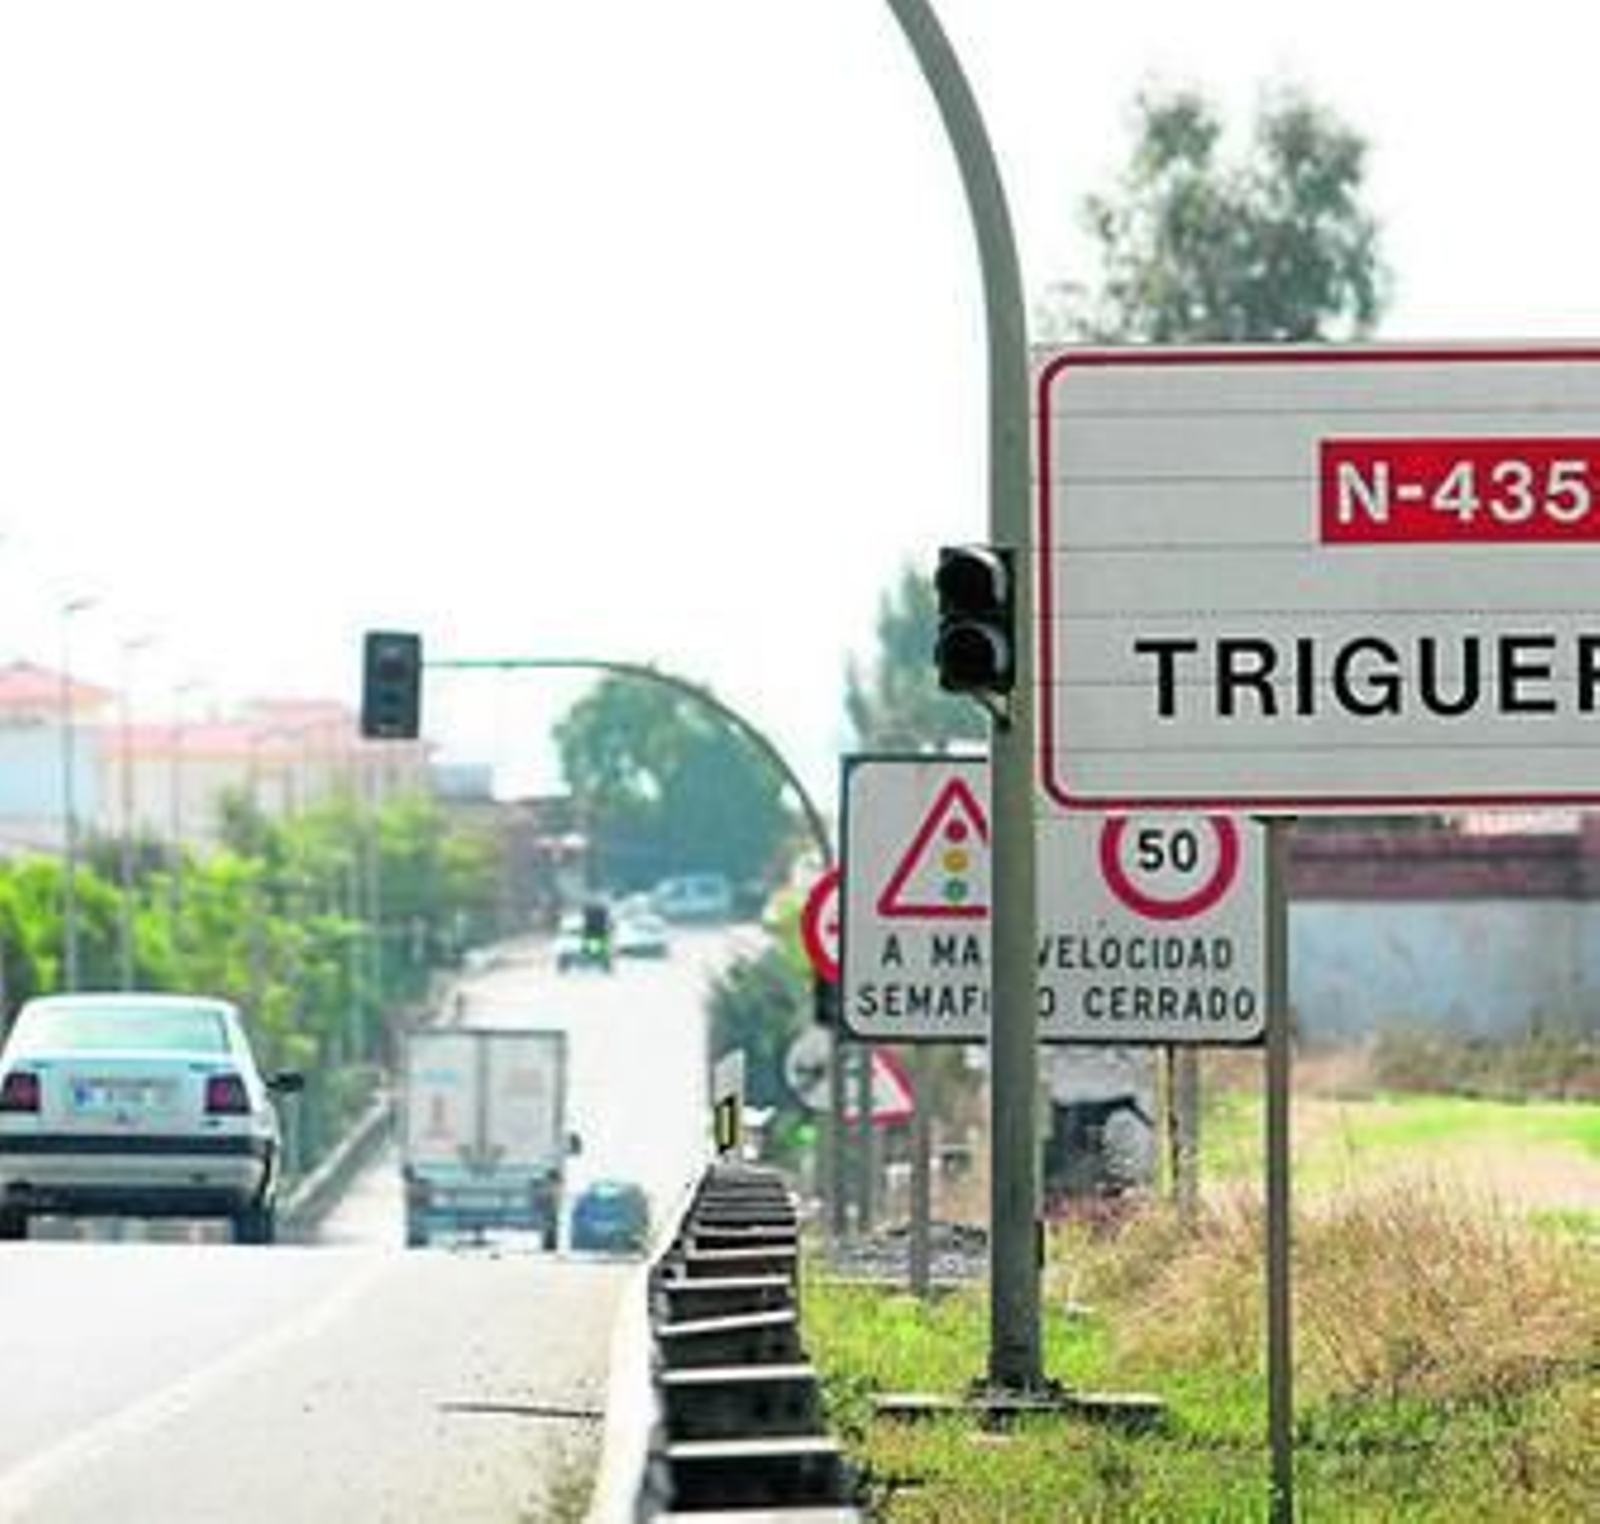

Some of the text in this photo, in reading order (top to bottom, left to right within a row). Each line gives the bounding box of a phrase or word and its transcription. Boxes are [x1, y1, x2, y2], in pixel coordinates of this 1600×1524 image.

[1337, 460, 1591, 523] N-435
[1138, 829, 1198, 873] 50
[881, 934, 903, 967] A
[931, 935, 984, 967] MA
[1082, 985, 1256, 1021] CERRADO
